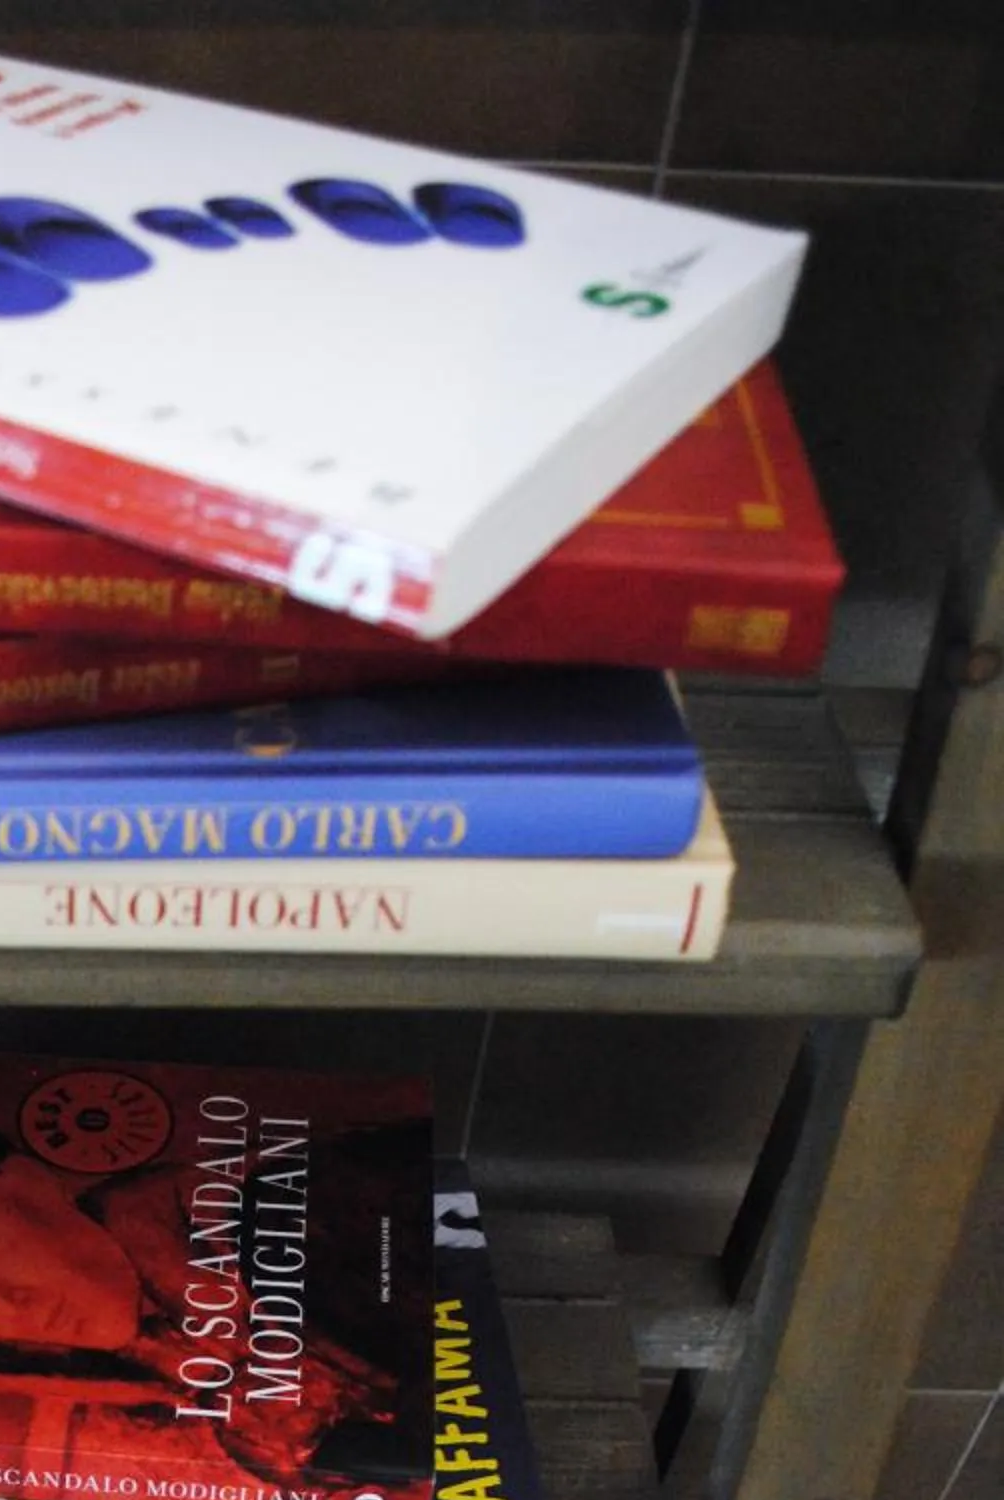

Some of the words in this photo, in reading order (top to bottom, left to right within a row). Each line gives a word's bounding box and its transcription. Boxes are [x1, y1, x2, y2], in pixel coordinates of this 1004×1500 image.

[250, 804, 468, 853] CARLO
[44, 884, 412, 933] NAPOLEONE
[181, 1094, 250, 1341] SCANDALO
[245, 1115, 310, 1407] MODIGLIANI
[175, 1355, 236, 1422] LO
